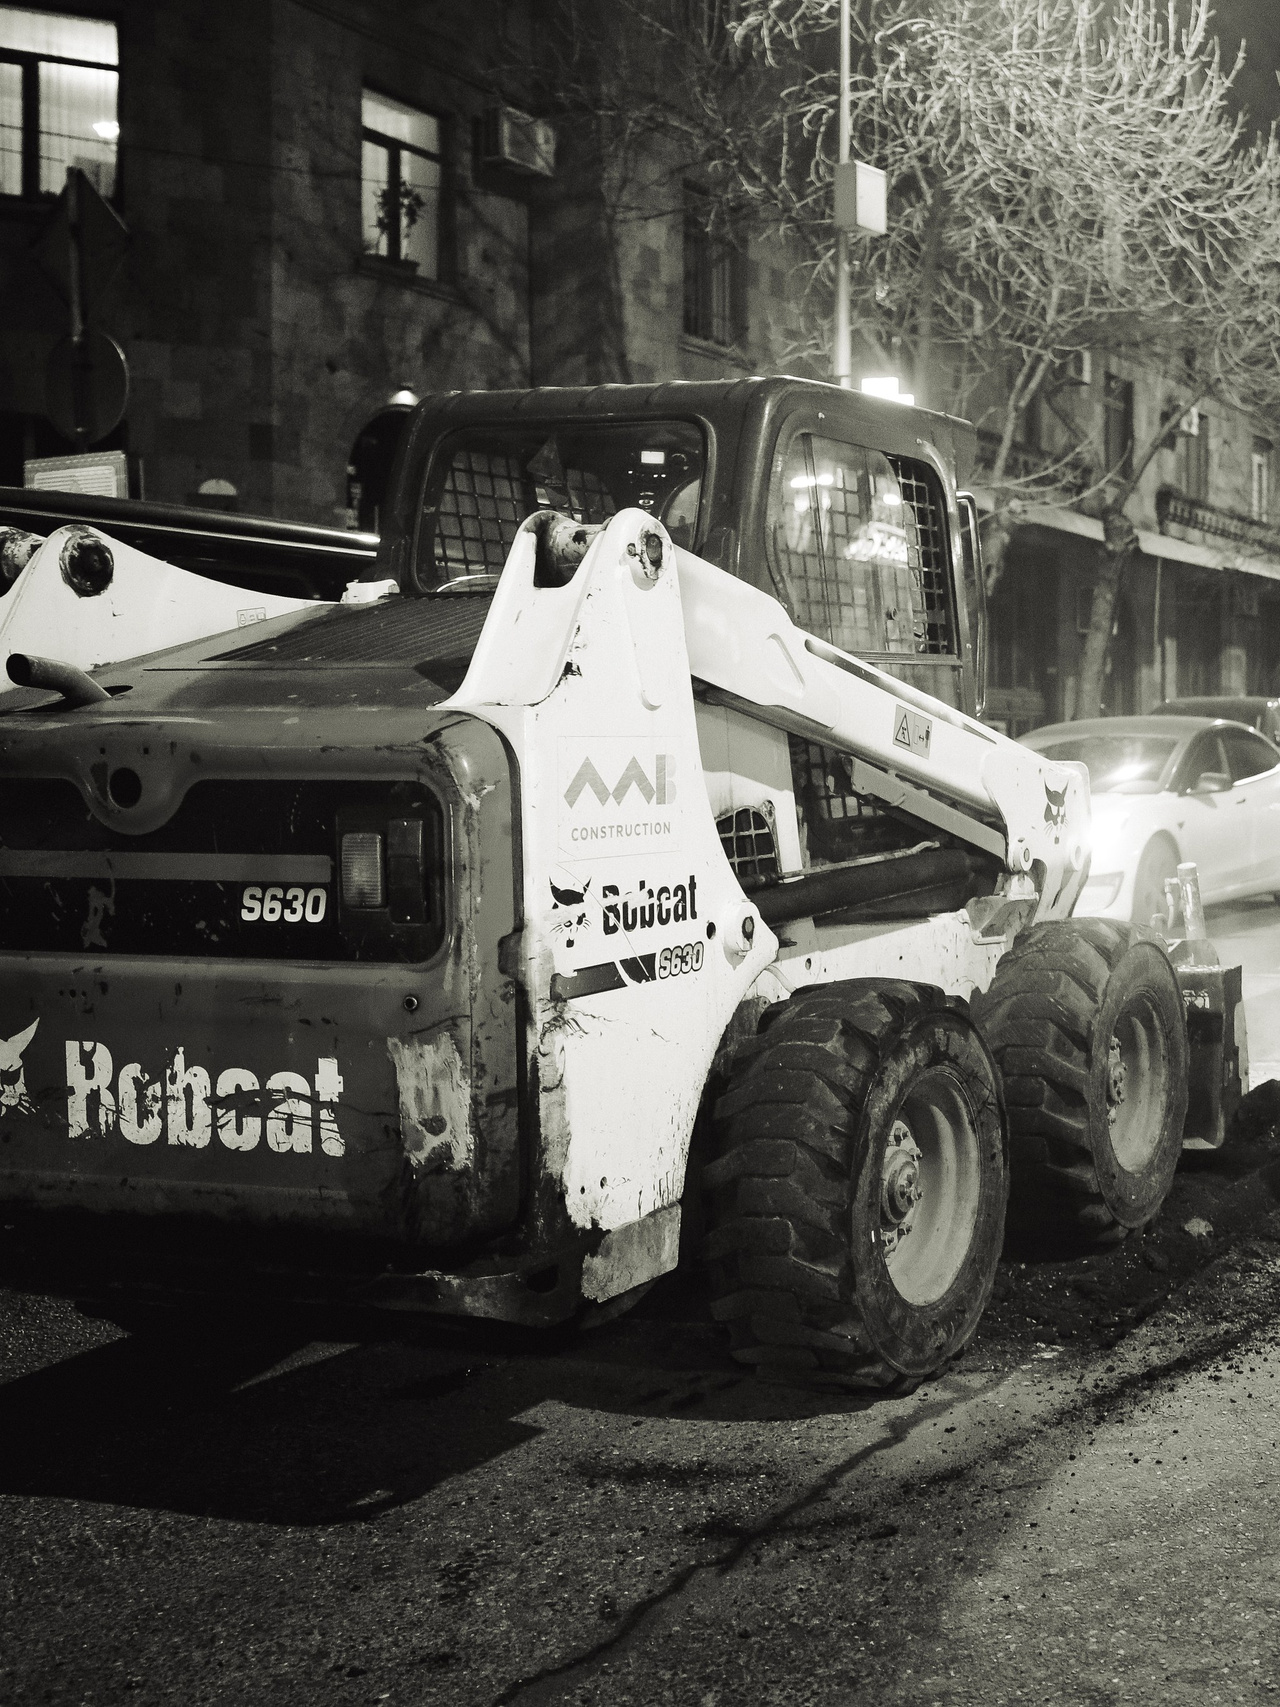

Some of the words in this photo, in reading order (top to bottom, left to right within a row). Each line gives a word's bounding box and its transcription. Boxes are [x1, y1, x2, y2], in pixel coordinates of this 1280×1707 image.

[570, 821, 672, 842] CONSTRUCTION
[240, 886, 327, 924] S630
[602, 874, 698, 936] Bobcat
[658, 941, 705, 980] S630
